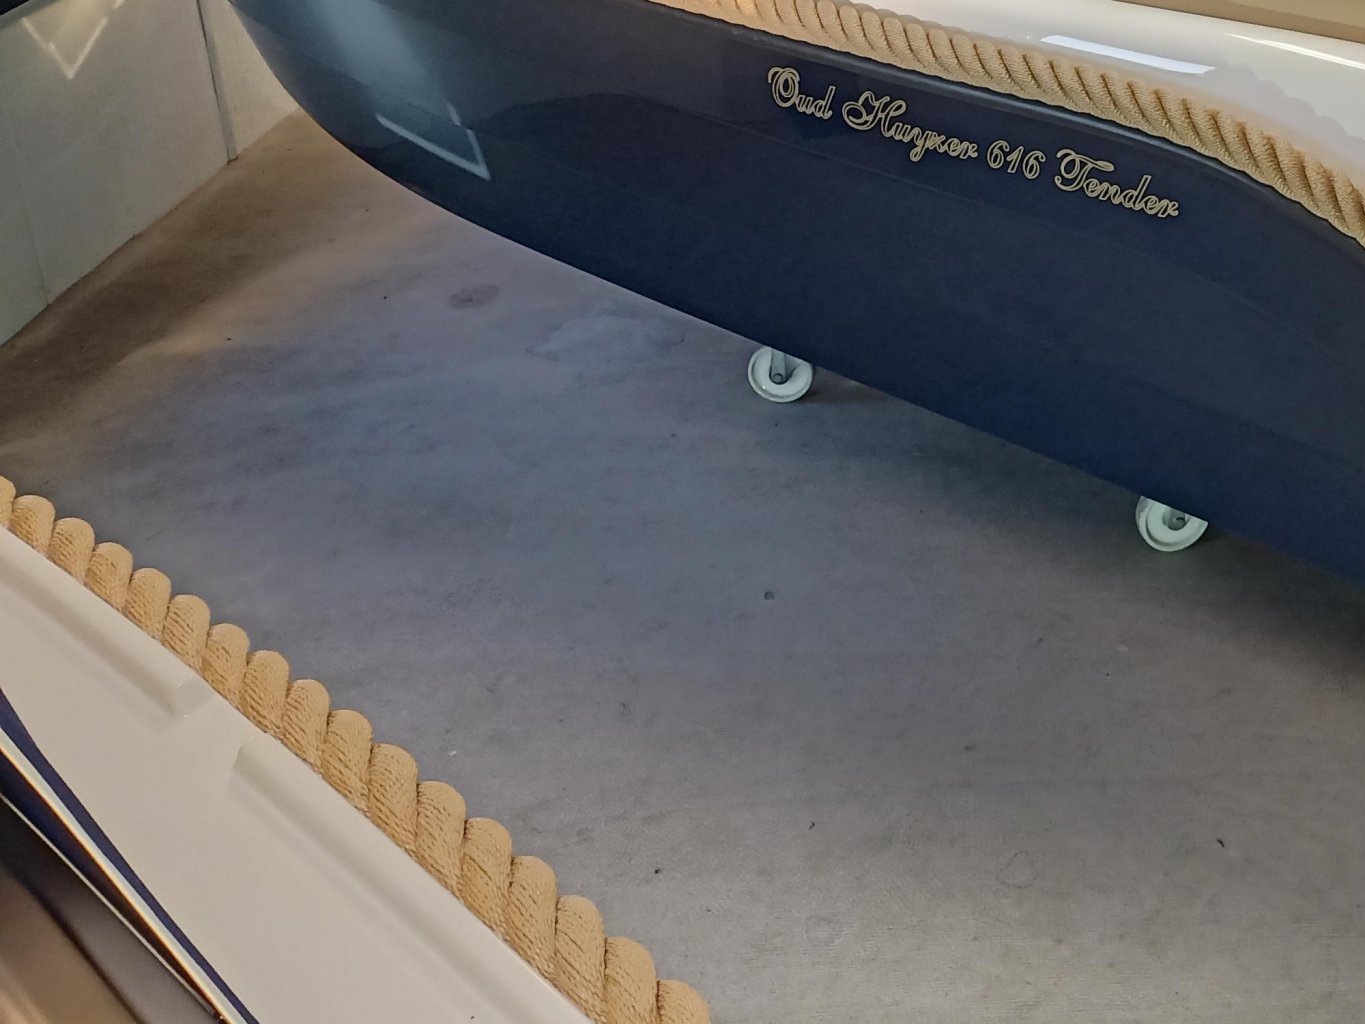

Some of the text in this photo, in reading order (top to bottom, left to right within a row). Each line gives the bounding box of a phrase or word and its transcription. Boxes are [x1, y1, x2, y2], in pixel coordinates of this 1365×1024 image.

[768, 67, 836, 120] Oud
[987, 140, 1046, 179] 616
[1054, 149, 1179, 218] Tender
